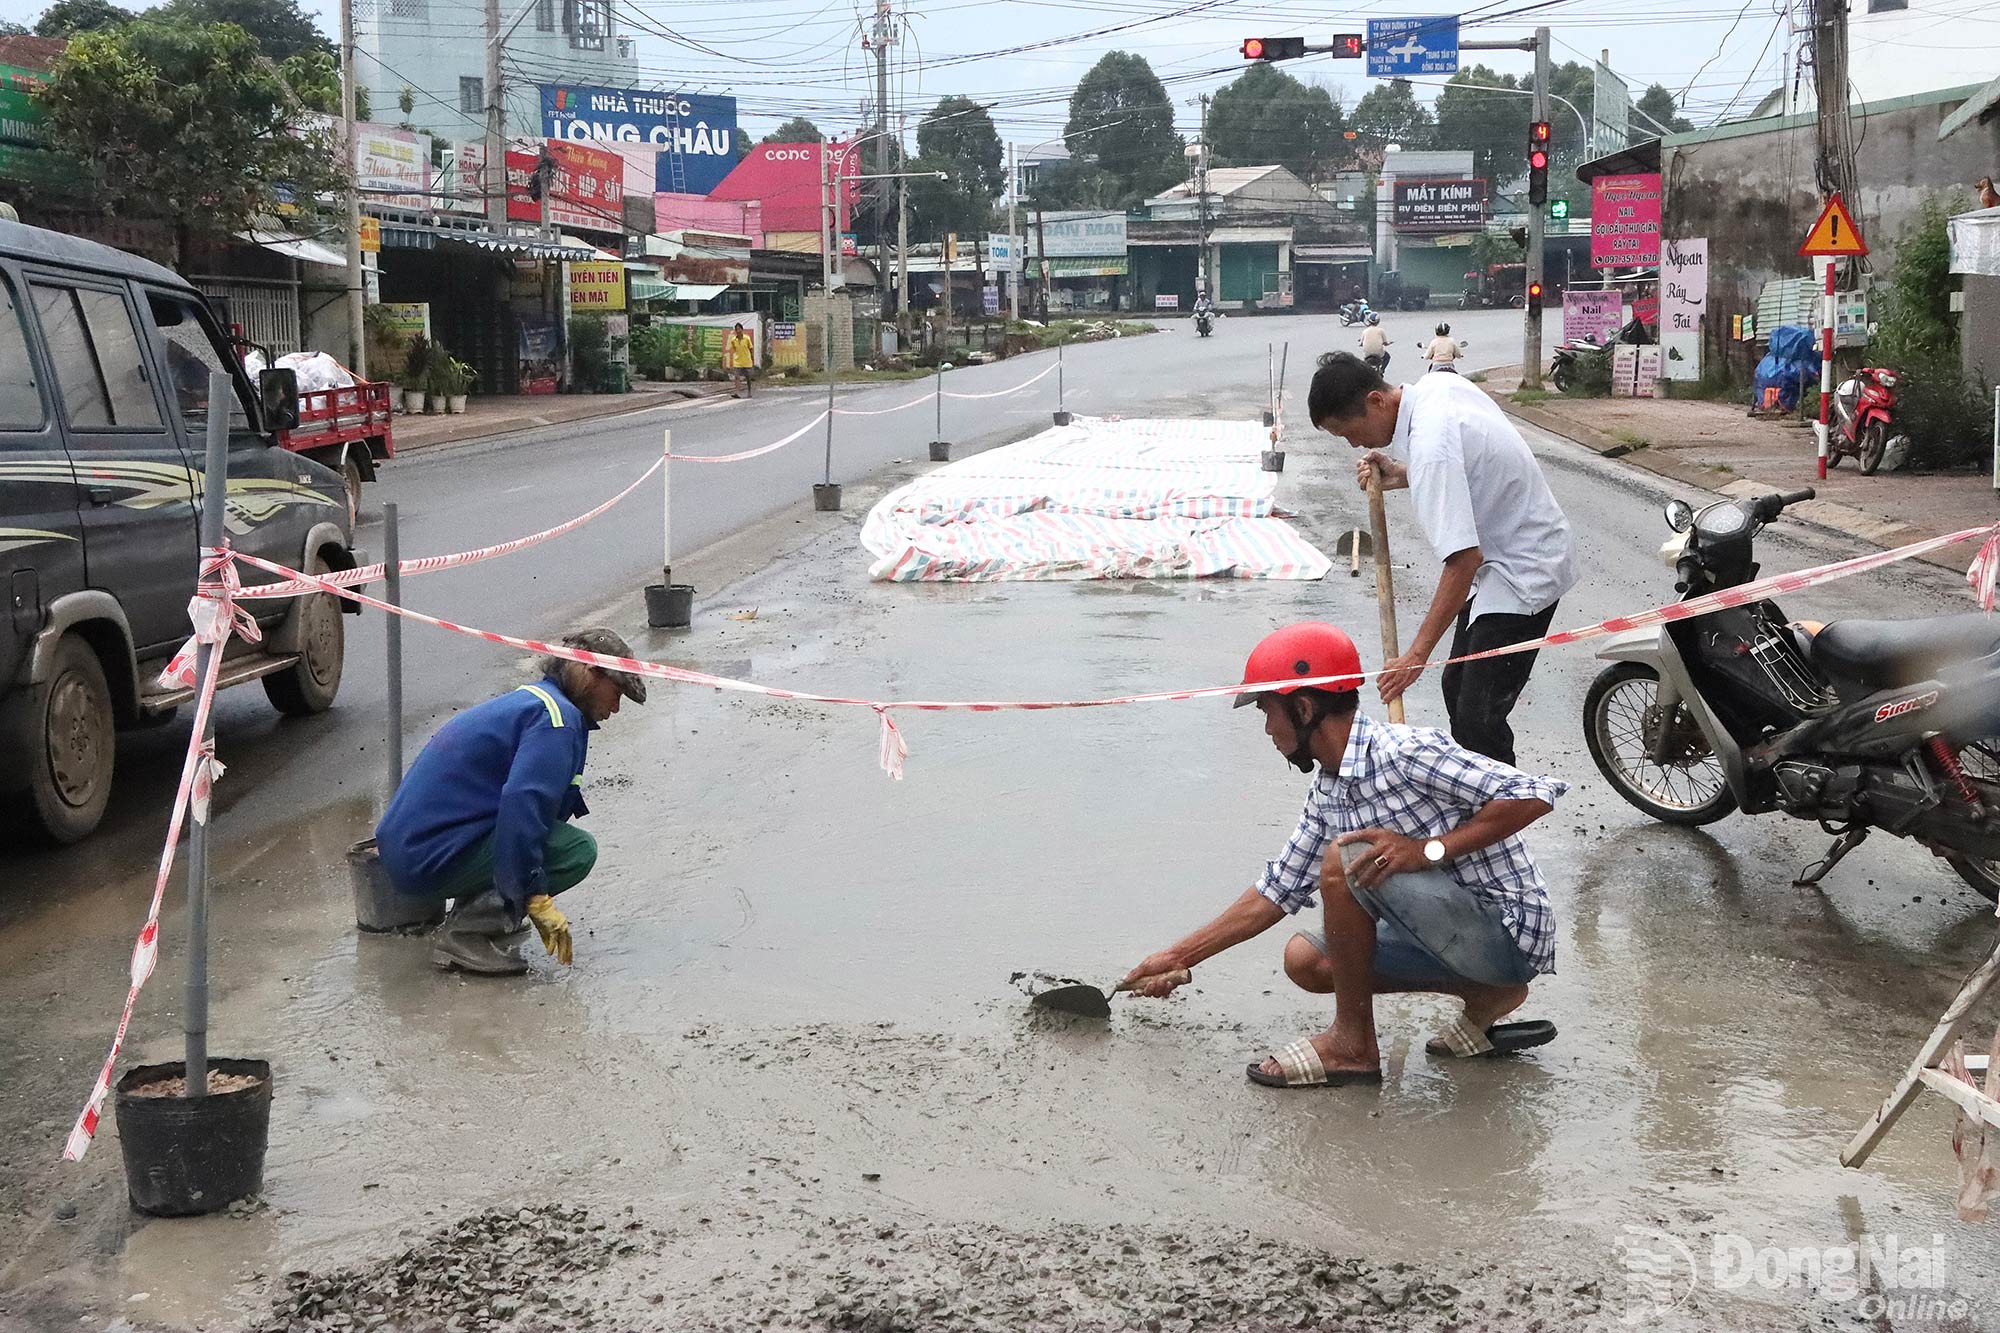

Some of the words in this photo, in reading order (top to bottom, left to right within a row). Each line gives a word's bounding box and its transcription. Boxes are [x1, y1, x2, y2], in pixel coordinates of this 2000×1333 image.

[1346, 38, 1358, 54] 4
[591, 91, 629, 113] NHÀ
[632, 93, 691, 117] THUỐC
[553, 119, 641, 143] LONG
[650, 120, 730, 156] CHÂU
[1537, 126, 1548, 140] 4
[1407, 182, 1437, 201] MẮT
[1441, 183, 1472, 200] KÍNH
[1618, 207, 1635, 217] NAIL
[1604, 255, 1619, 264] 097
[1621, 254, 1636, 263] 357
[1638, 253, 1657, 262] 1670
[1666, 282, 1702, 305] Ráy
[1582, 305, 1601, 315] Nail
[1673, 312, 1691, 329] Tai
